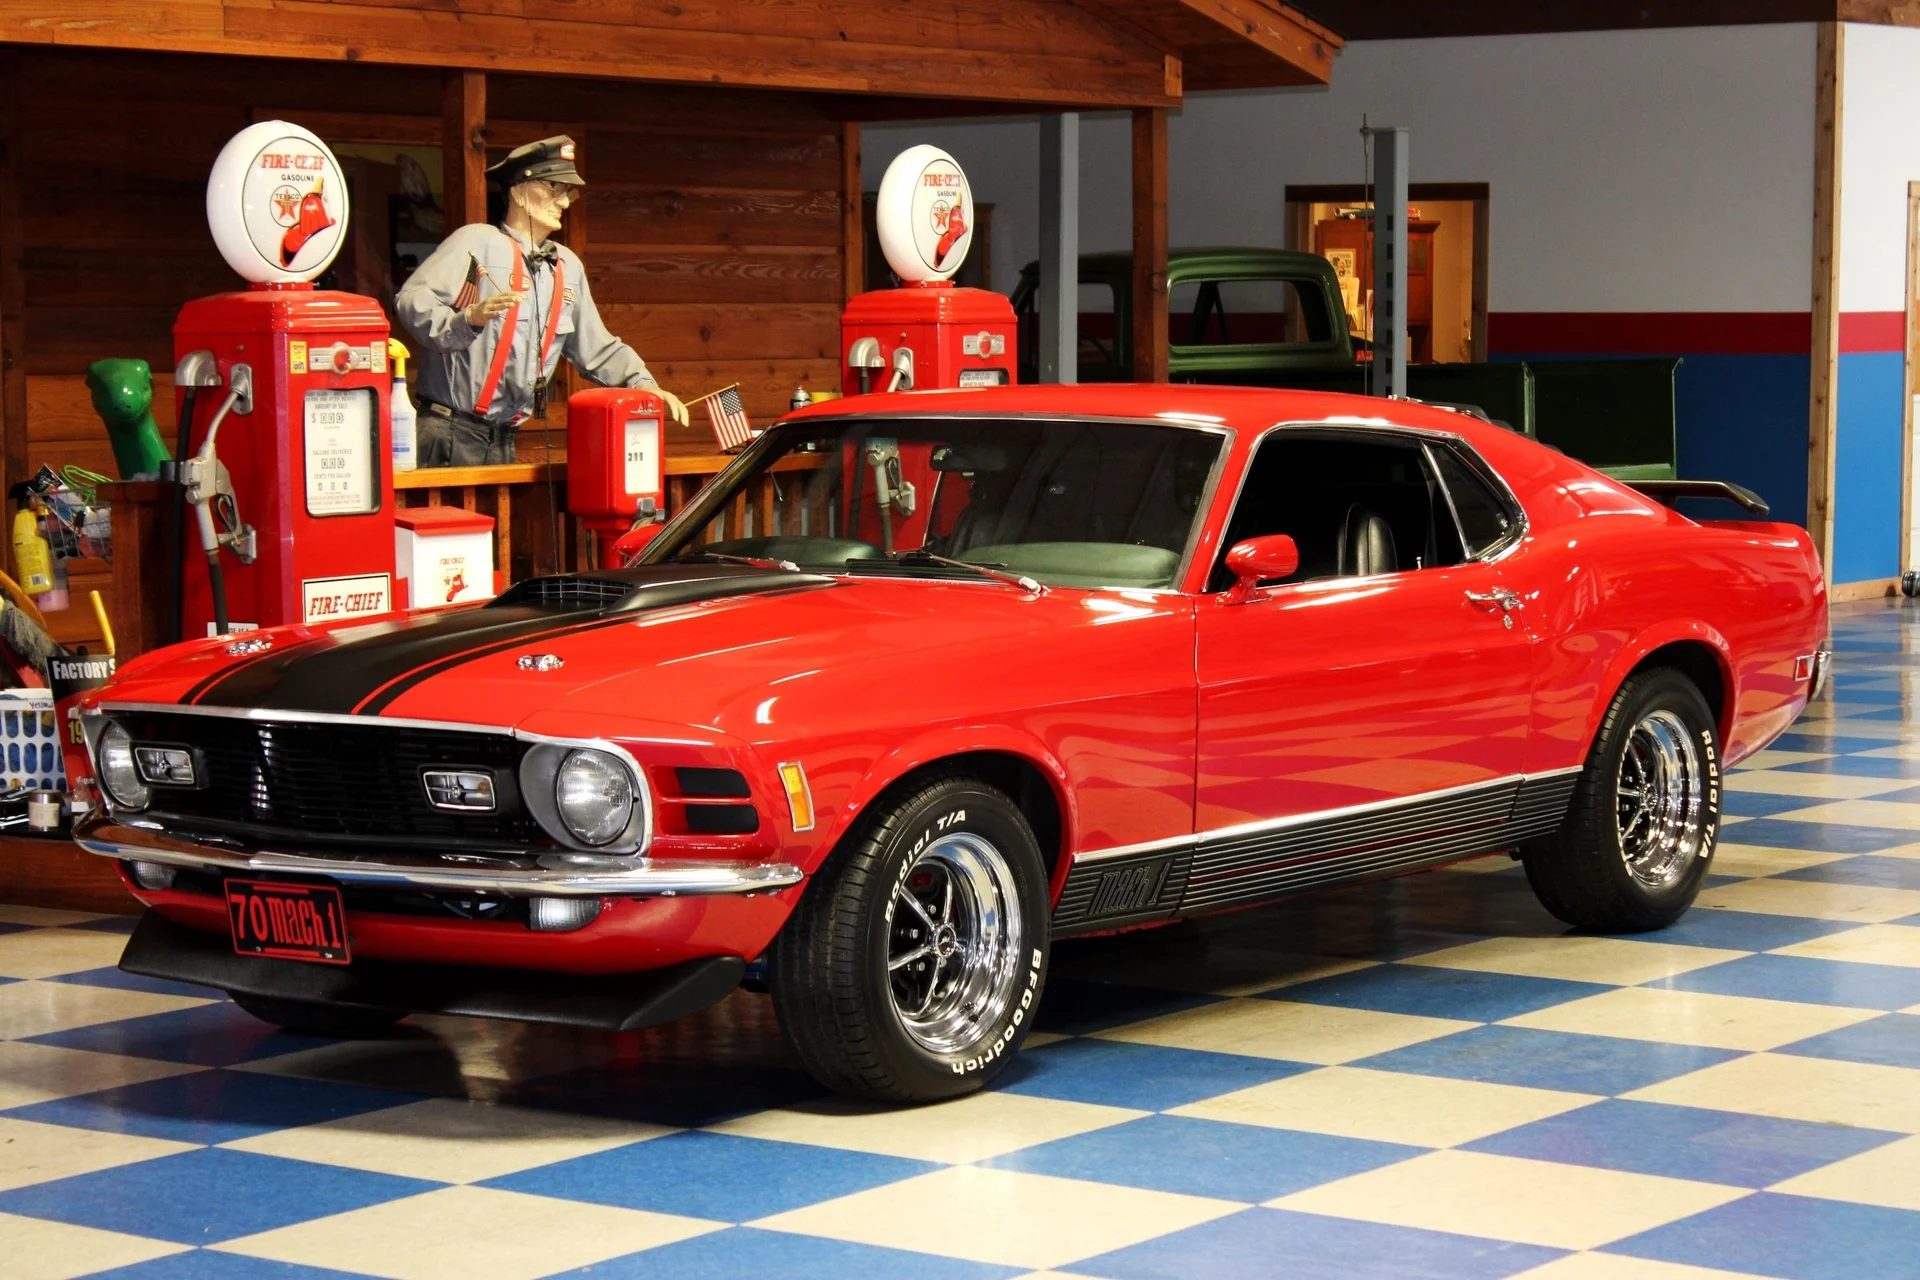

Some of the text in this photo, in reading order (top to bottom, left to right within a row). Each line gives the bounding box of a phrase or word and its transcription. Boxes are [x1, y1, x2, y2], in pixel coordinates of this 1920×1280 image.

[281, 174, 315, 182] GASOLINE
[924, 174, 960, 187] FIRE-C
[309, 592, 383, 616] FIRE-CHIEF
[1699, 729, 1718, 859] Radial T/A
[885, 810, 966, 923] Radial T/A
[952, 948, 1042, 1076] BFGoodrich
